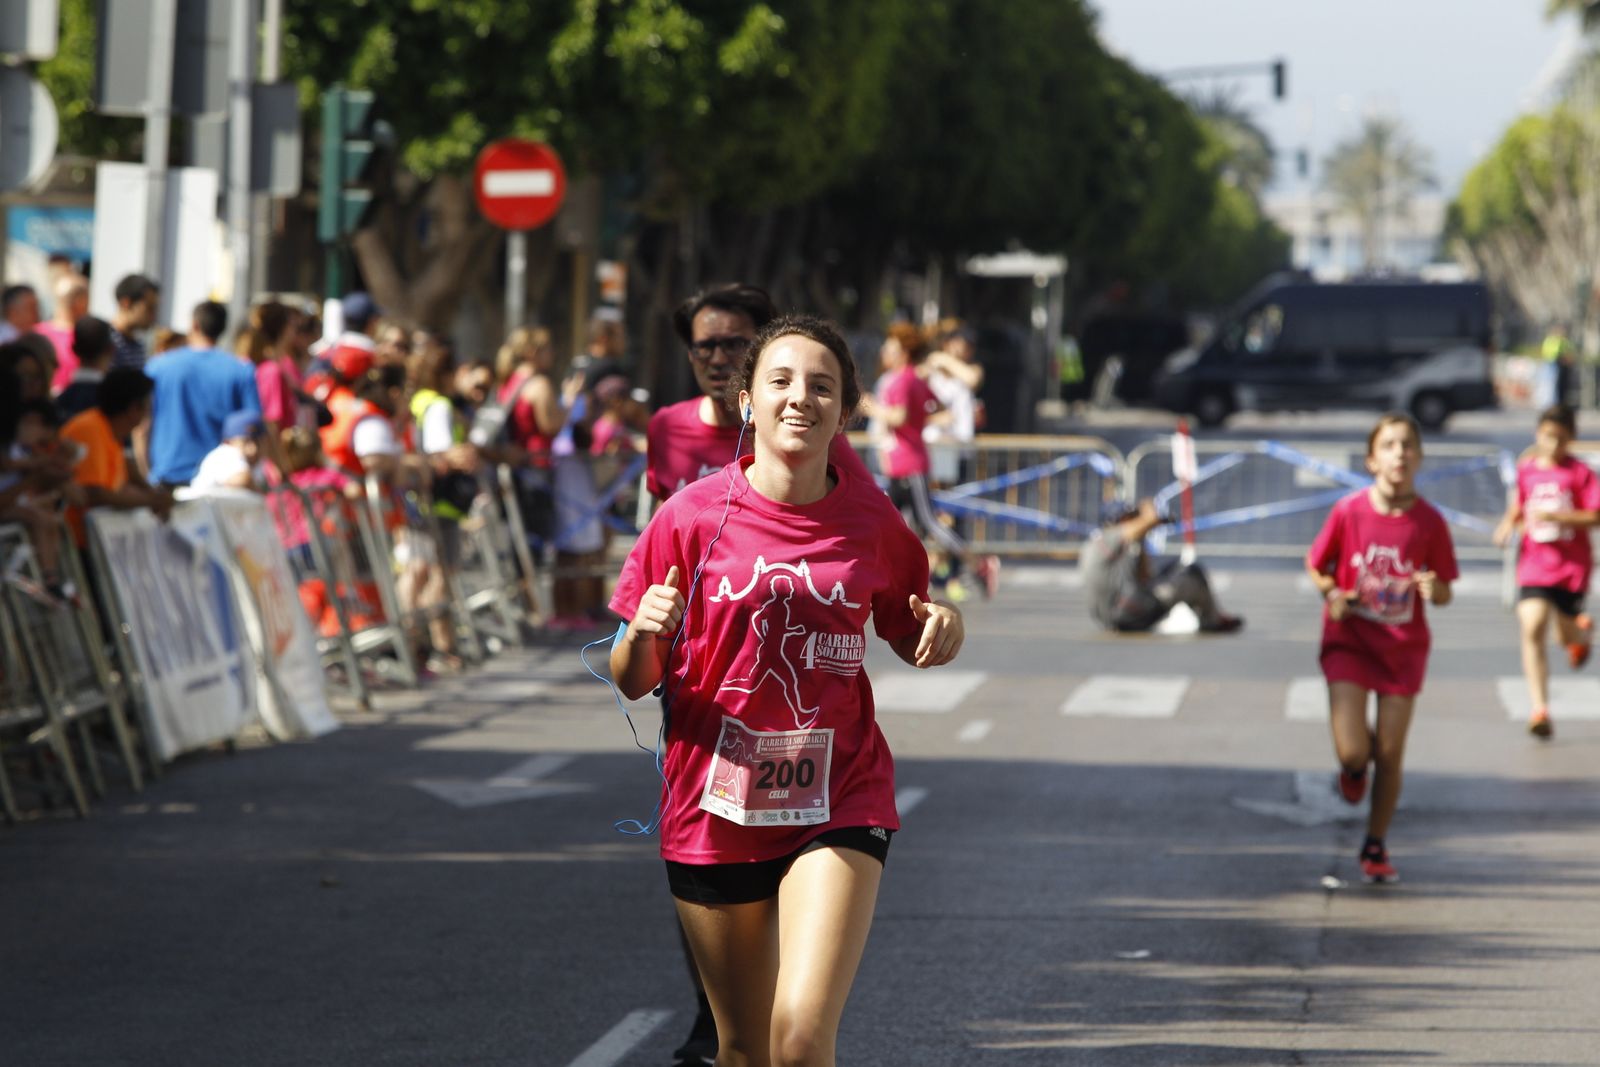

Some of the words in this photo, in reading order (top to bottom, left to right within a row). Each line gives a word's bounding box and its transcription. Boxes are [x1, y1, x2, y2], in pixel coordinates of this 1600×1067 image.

[799, 631, 817, 669] 4
[755, 758, 815, 789] 200
[768, 790, 789, 799] CELIA
